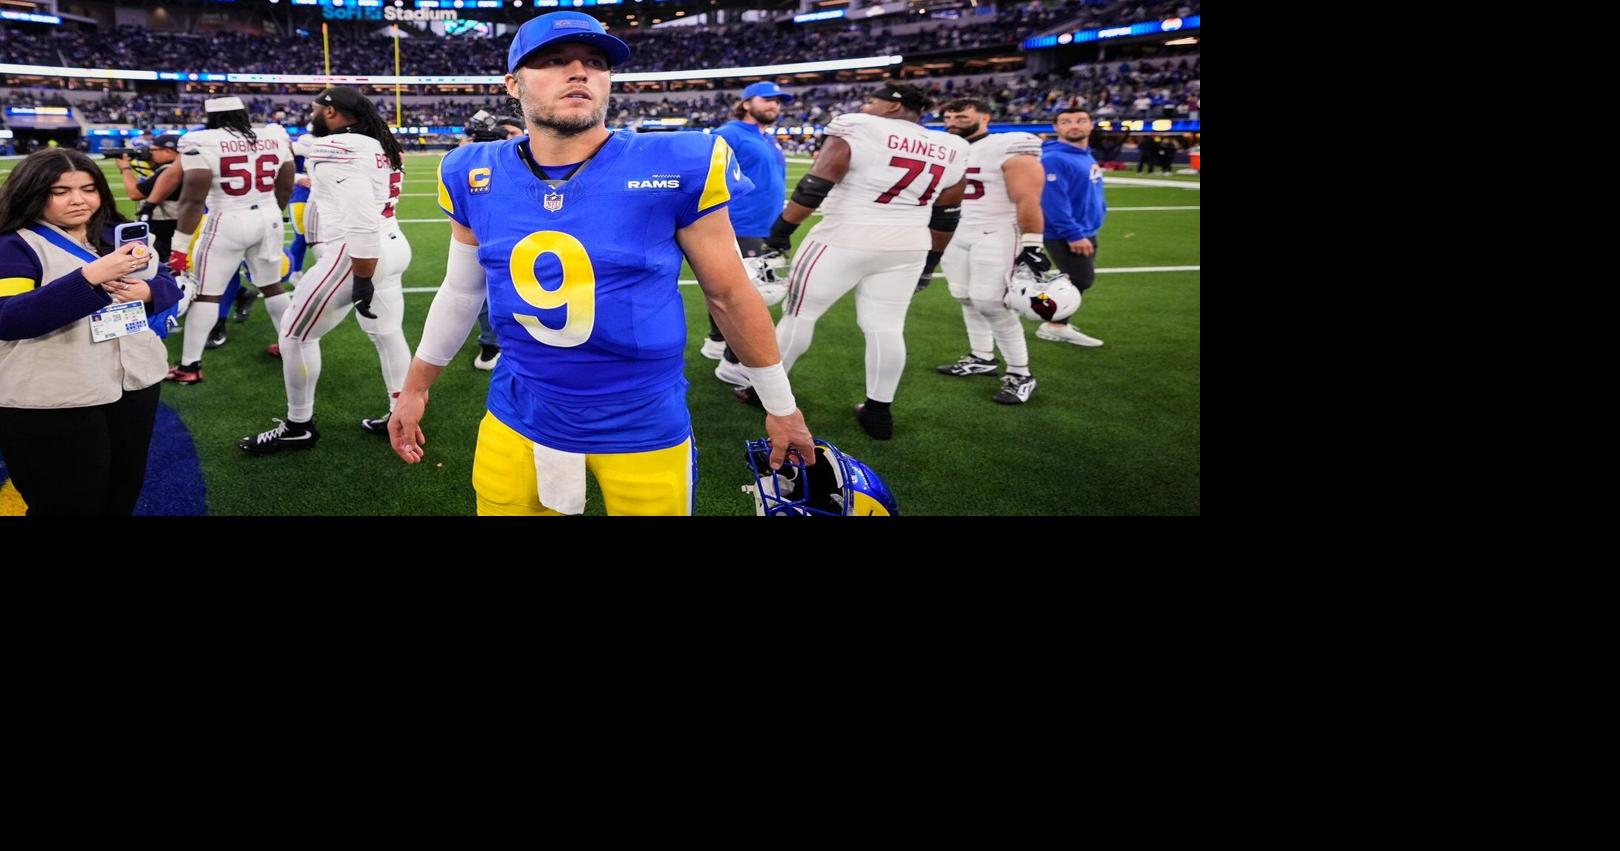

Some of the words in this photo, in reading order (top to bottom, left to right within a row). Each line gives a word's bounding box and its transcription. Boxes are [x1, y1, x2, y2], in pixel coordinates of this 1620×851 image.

[322, 6, 363, 20] SoFi
[384, 5, 458, 21] Stadium
[887, 134, 947, 161] GAINES
[219, 153, 280, 197] 56
[468, 167, 491, 188] C
[627, 180, 680, 189] RAMS
[874, 155, 946, 207] 71
[509, 230, 596, 348] 9
